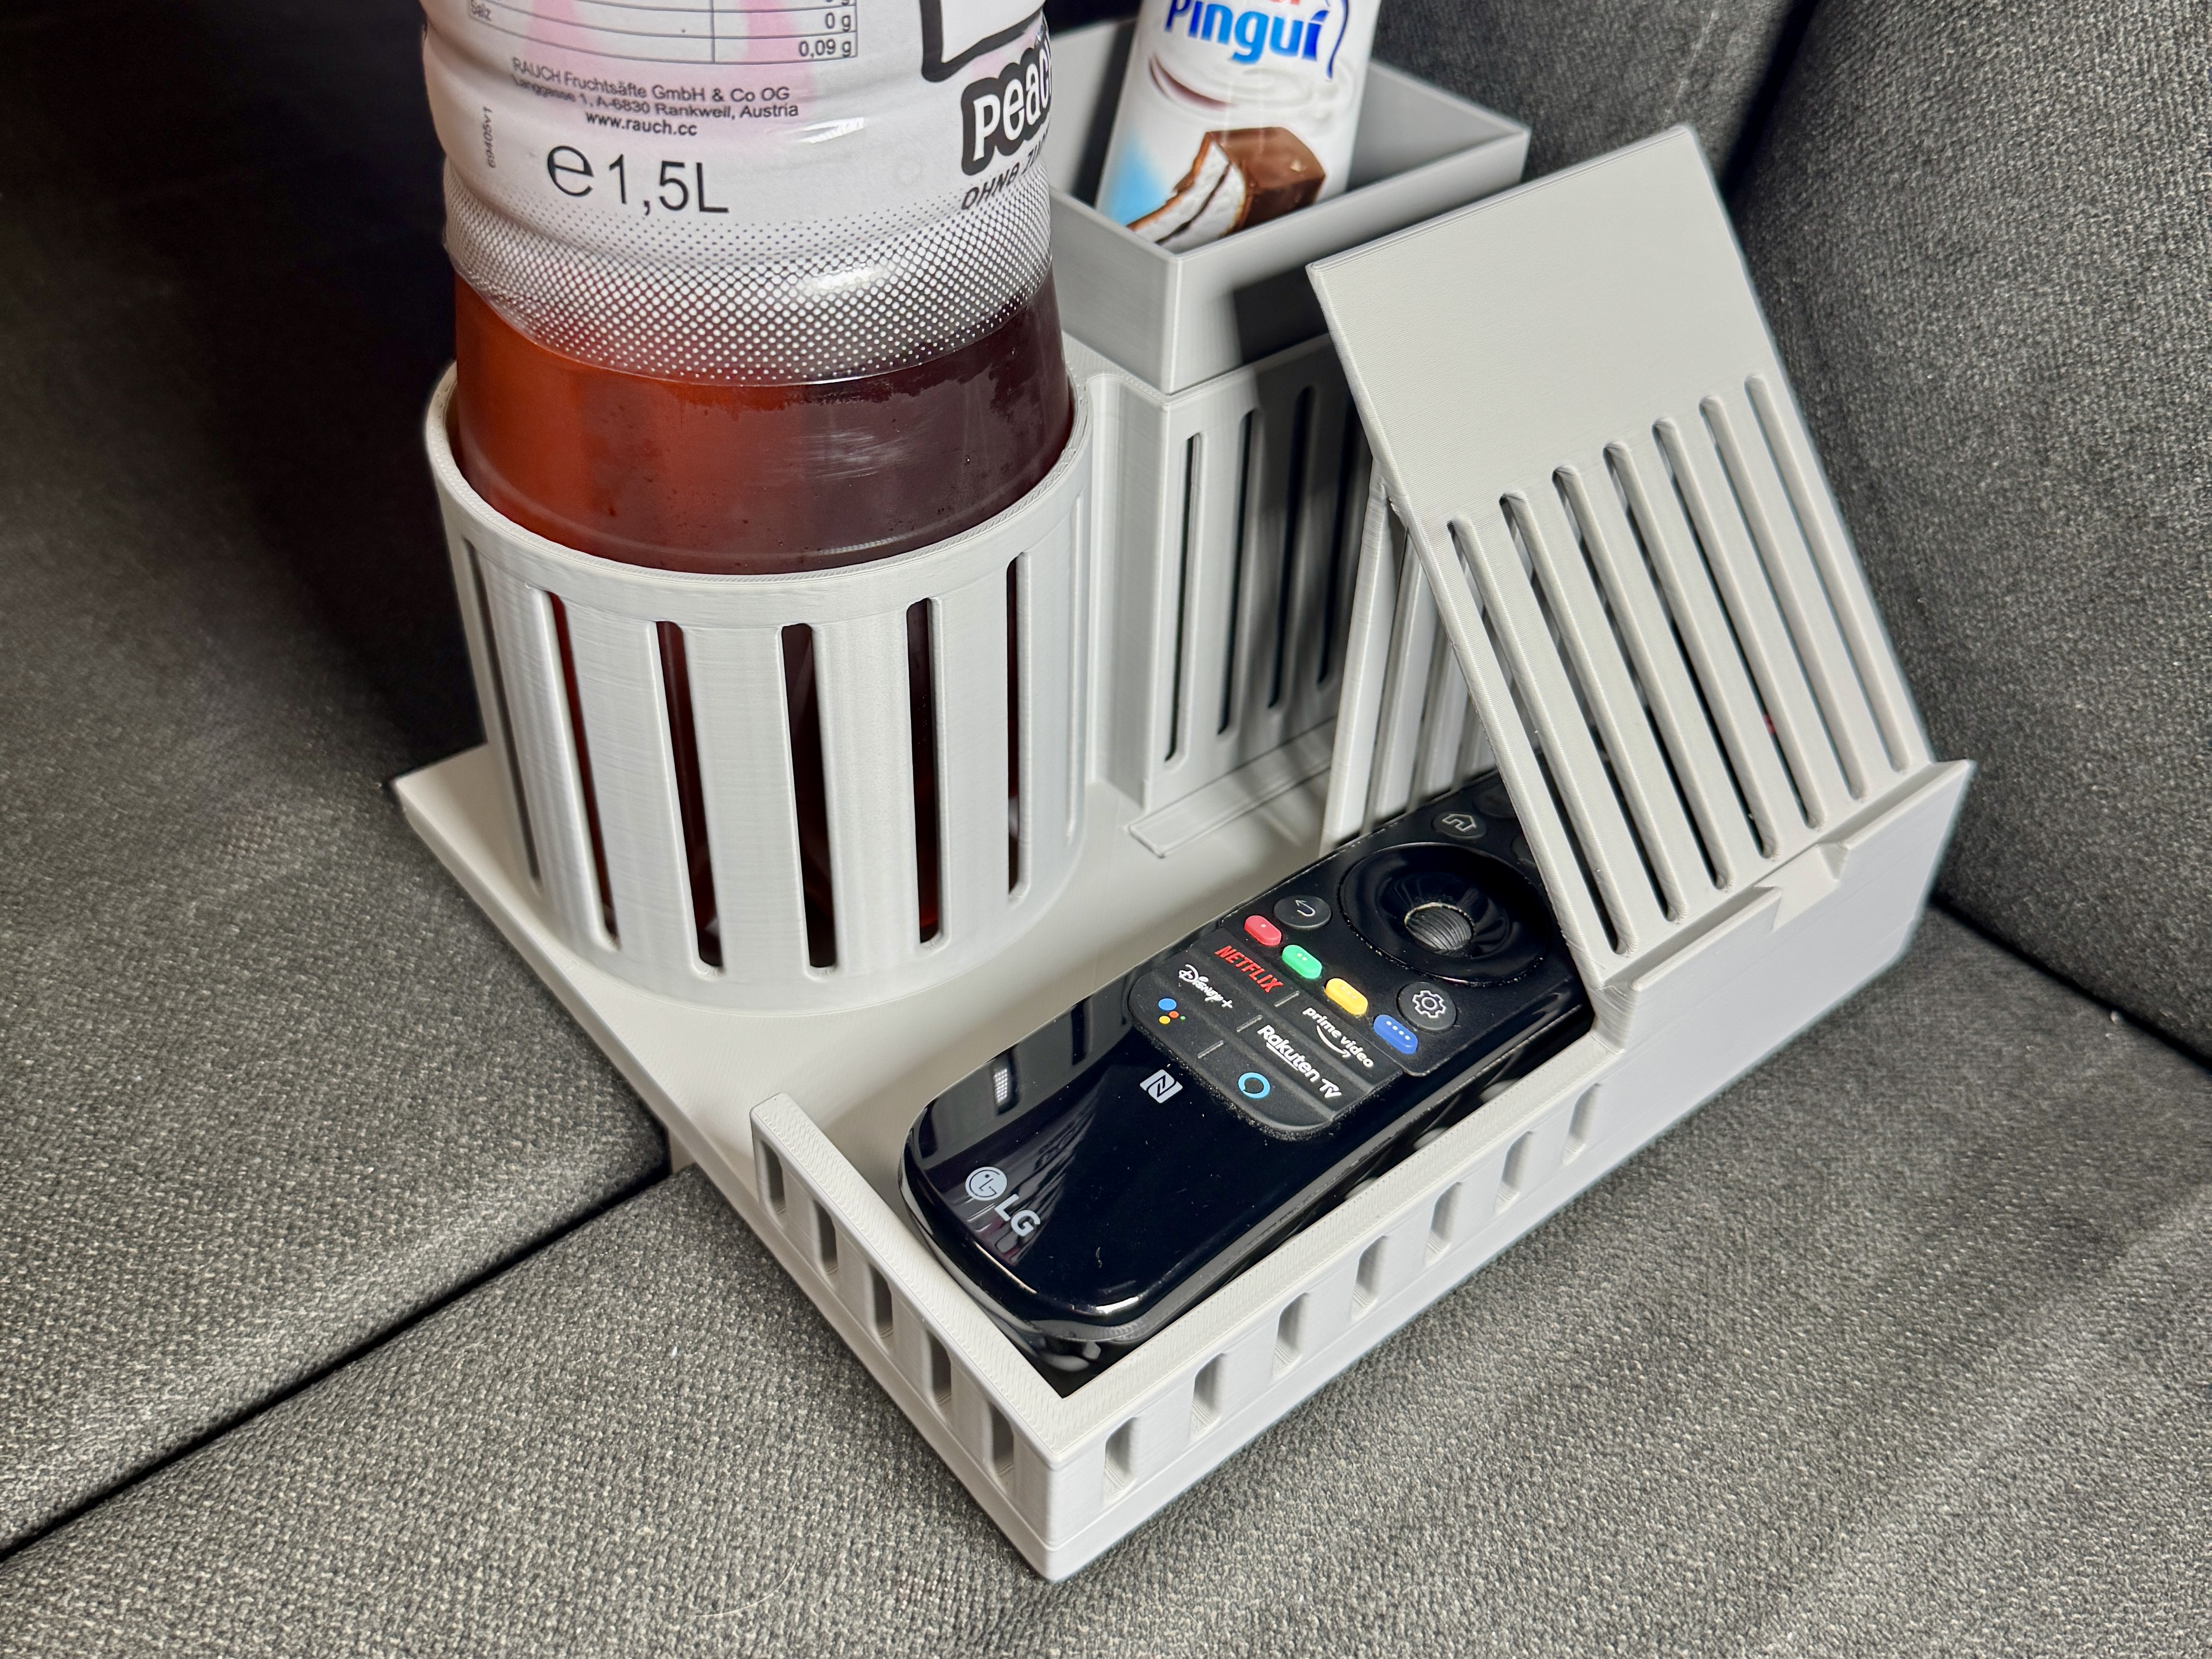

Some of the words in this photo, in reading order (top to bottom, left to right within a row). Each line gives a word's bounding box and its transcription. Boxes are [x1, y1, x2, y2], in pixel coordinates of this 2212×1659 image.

[825, 12, 835, 29] 0
[841, 14, 851, 32] g
[798, 38, 836, 59] 0,09
[842, 41, 851, 58] g
[511, 56, 561, 85] RAUCH
[564, 70, 647, 99] Fruchtsäfte
[651, 84, 705, 102] GmbH
[712, 87, 725, 102] &
[730, 87, 756, 102] Co
[761, 85, 791, 102] OG
[585, 111, 698, 136] www.rauch.cc
[595, 95, 651, 115] A-6830
[654, 103, 736, 120] Rankweil,
[739, 103, 799, 118] Austria
[608, 153, 730, 216] 1,5L
[1214, 945, 1284, 993] NETFLIX
[1302, 1007, 1342, 1038] prime
[1340, 1036, 1374, 1068] video
[1257, 1024, 1320, 1083] Rakuten
[1319, 1078, 1342, 1099] TV
[994, 1193, 1041, 1237] LG
